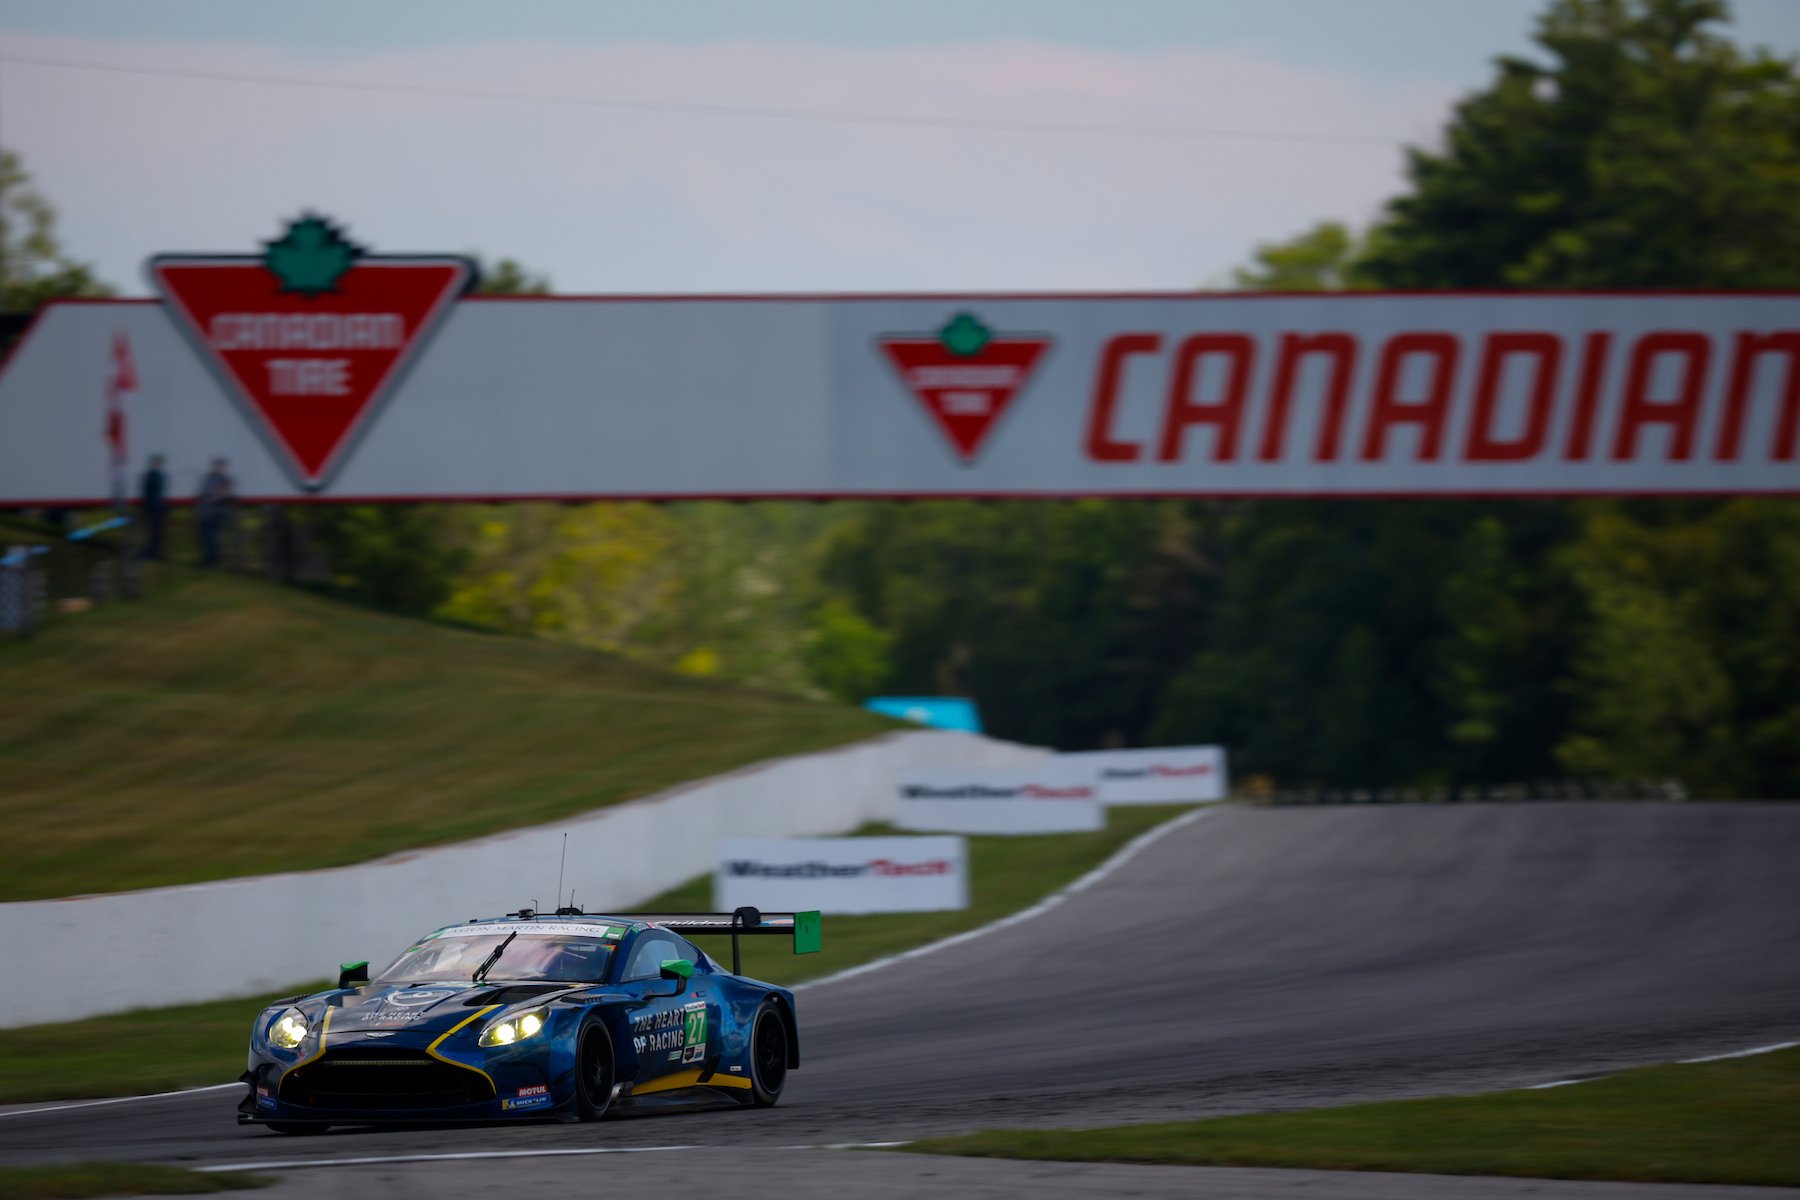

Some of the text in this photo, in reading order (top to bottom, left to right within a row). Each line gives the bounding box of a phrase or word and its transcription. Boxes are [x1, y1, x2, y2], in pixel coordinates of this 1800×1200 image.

[208, 311, 405, 350] CANADIAN
[264, 357, 354, 397] TIRE
[1084, 328, 1800, 463] CANADIAN
[726, 859, 953, 879] WeatherTech
[495, 923, 543, 933] MARTIN
[547, 925, 600, 934] RACING
[633, 1007, 685, 1034] THE HEART
[688, 1011, 705, 1045] 27
[633, 1029, 685, 1055] OF RACING
[518, 1085, 547, 1097] MOTUL
